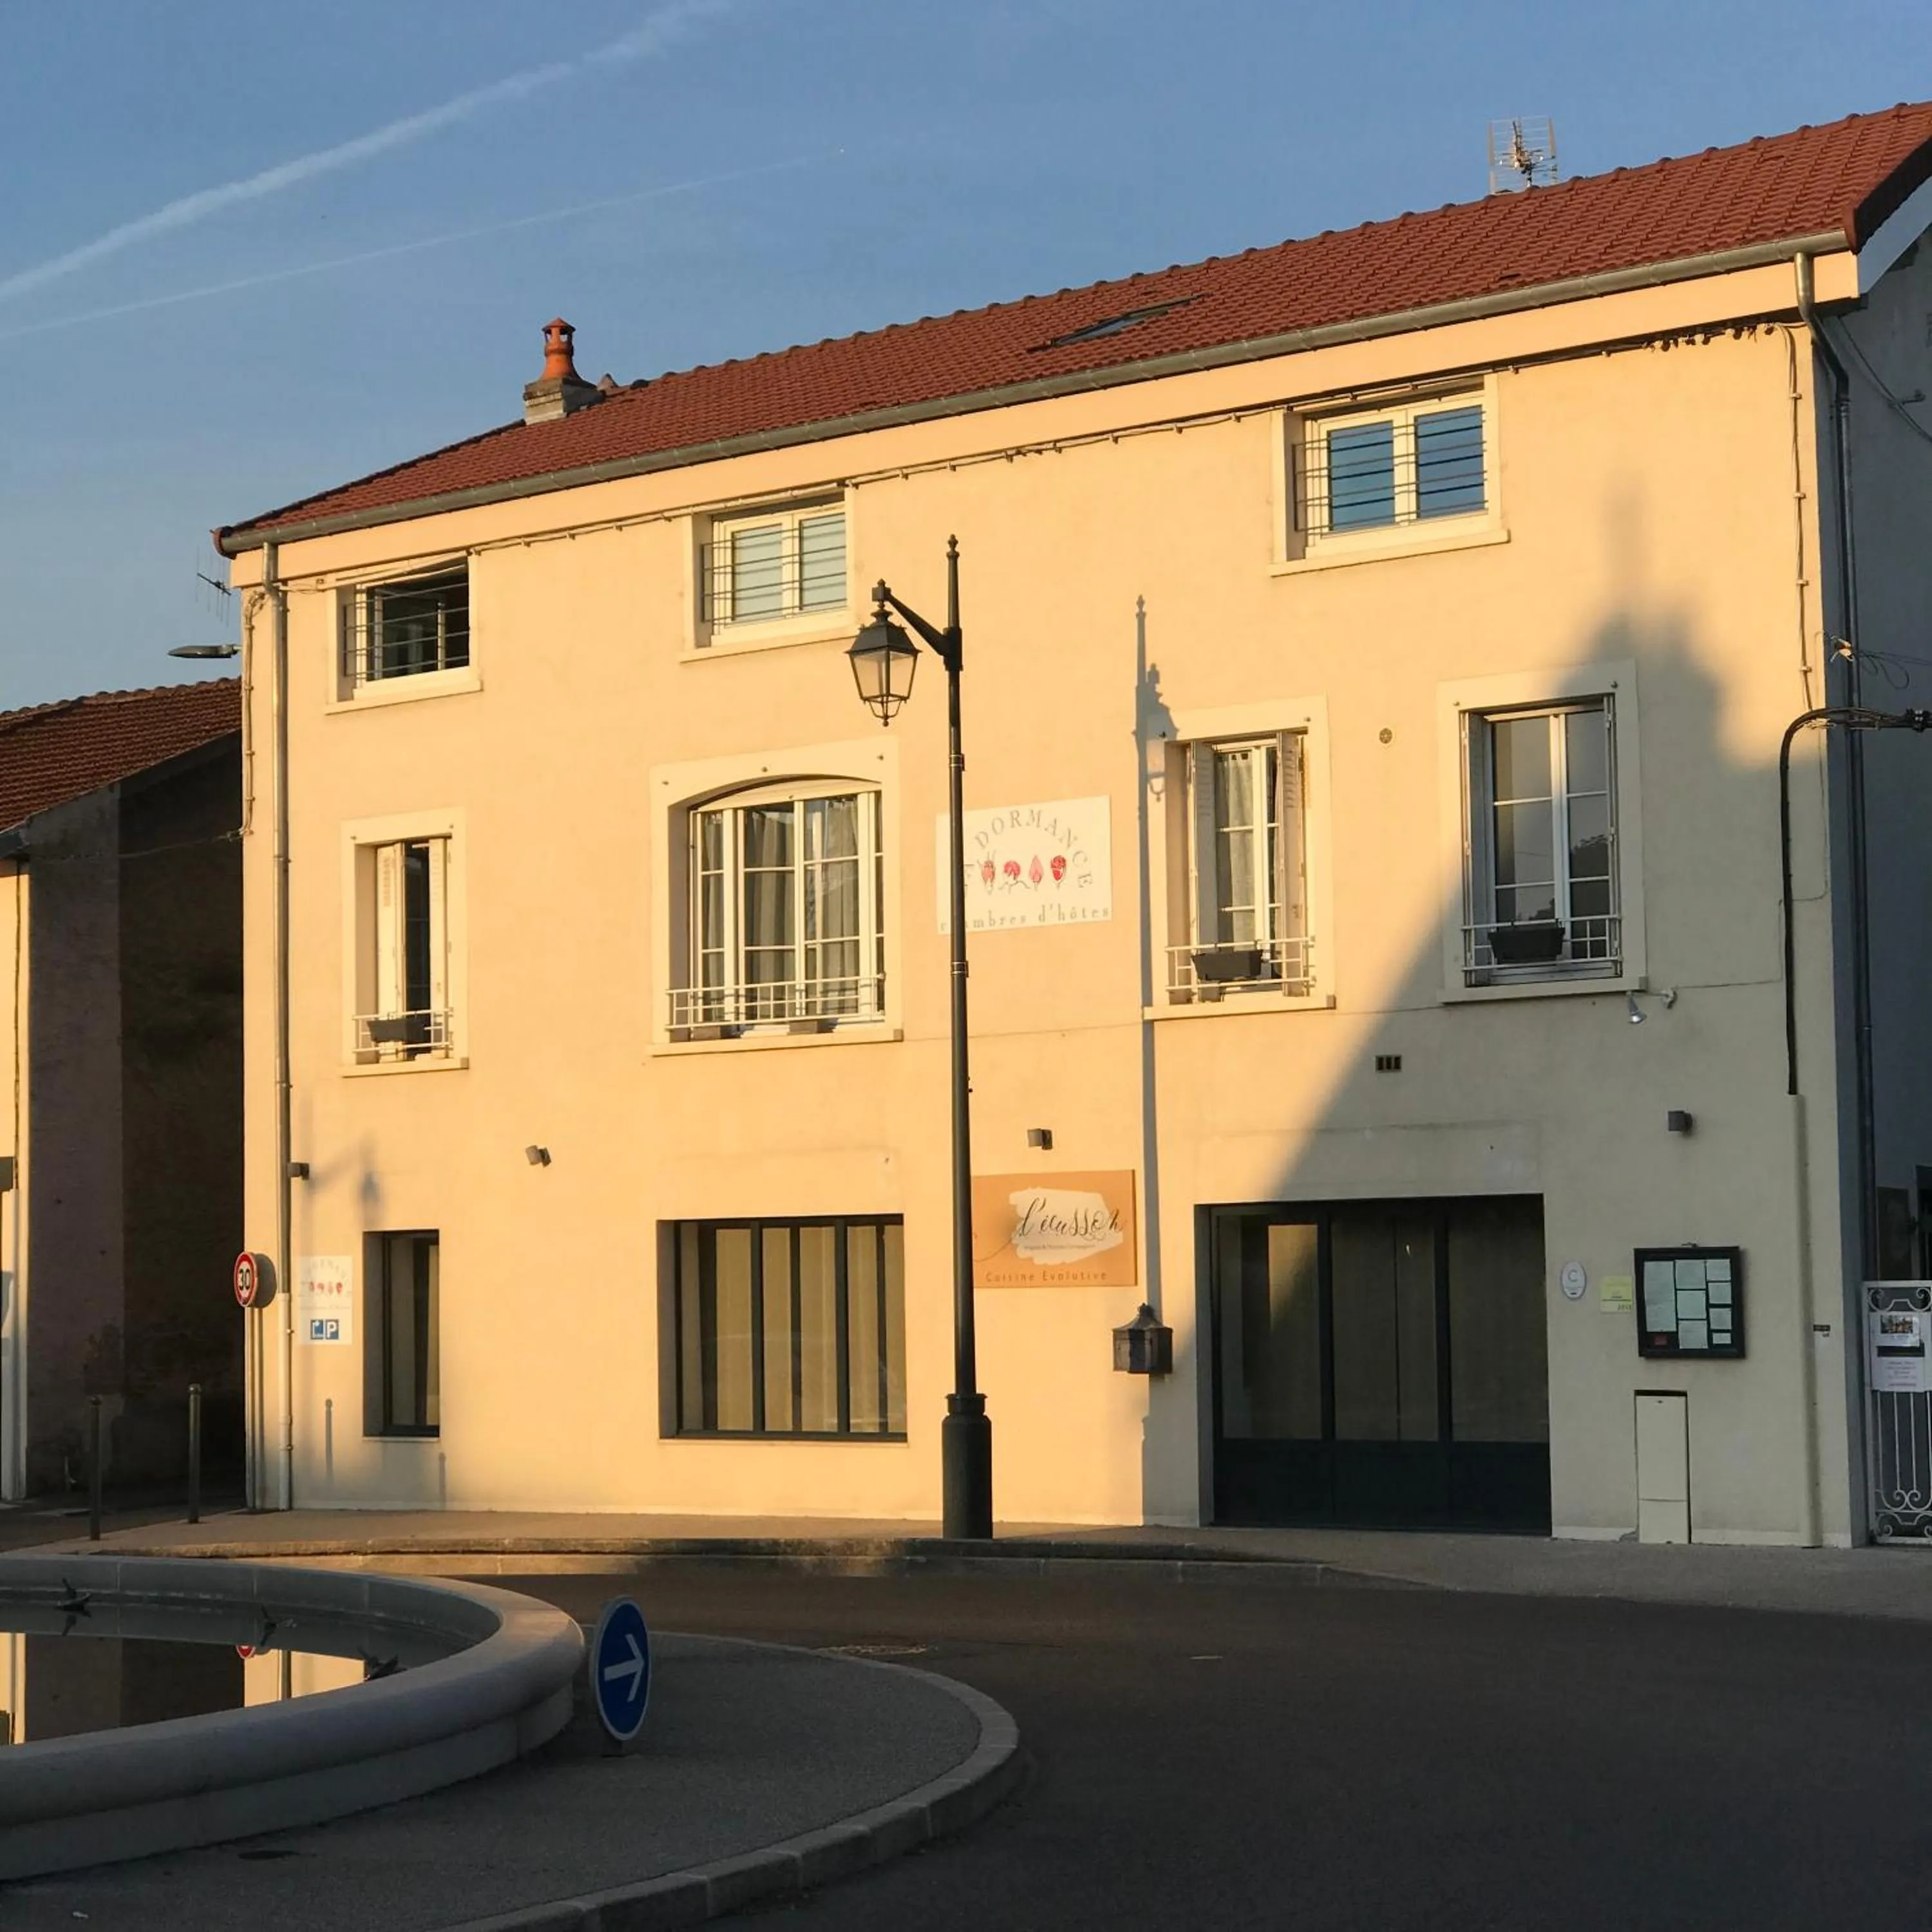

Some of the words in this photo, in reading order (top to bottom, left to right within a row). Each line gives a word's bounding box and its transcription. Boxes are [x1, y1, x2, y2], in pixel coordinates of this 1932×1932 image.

[974, 809, 1094, 889] DORMANCE
[940, 909, 1027, 931] cmbres
[239, 1268, 251, 1291] 30
[985, 1271, 1035, 1282] Cuisine
